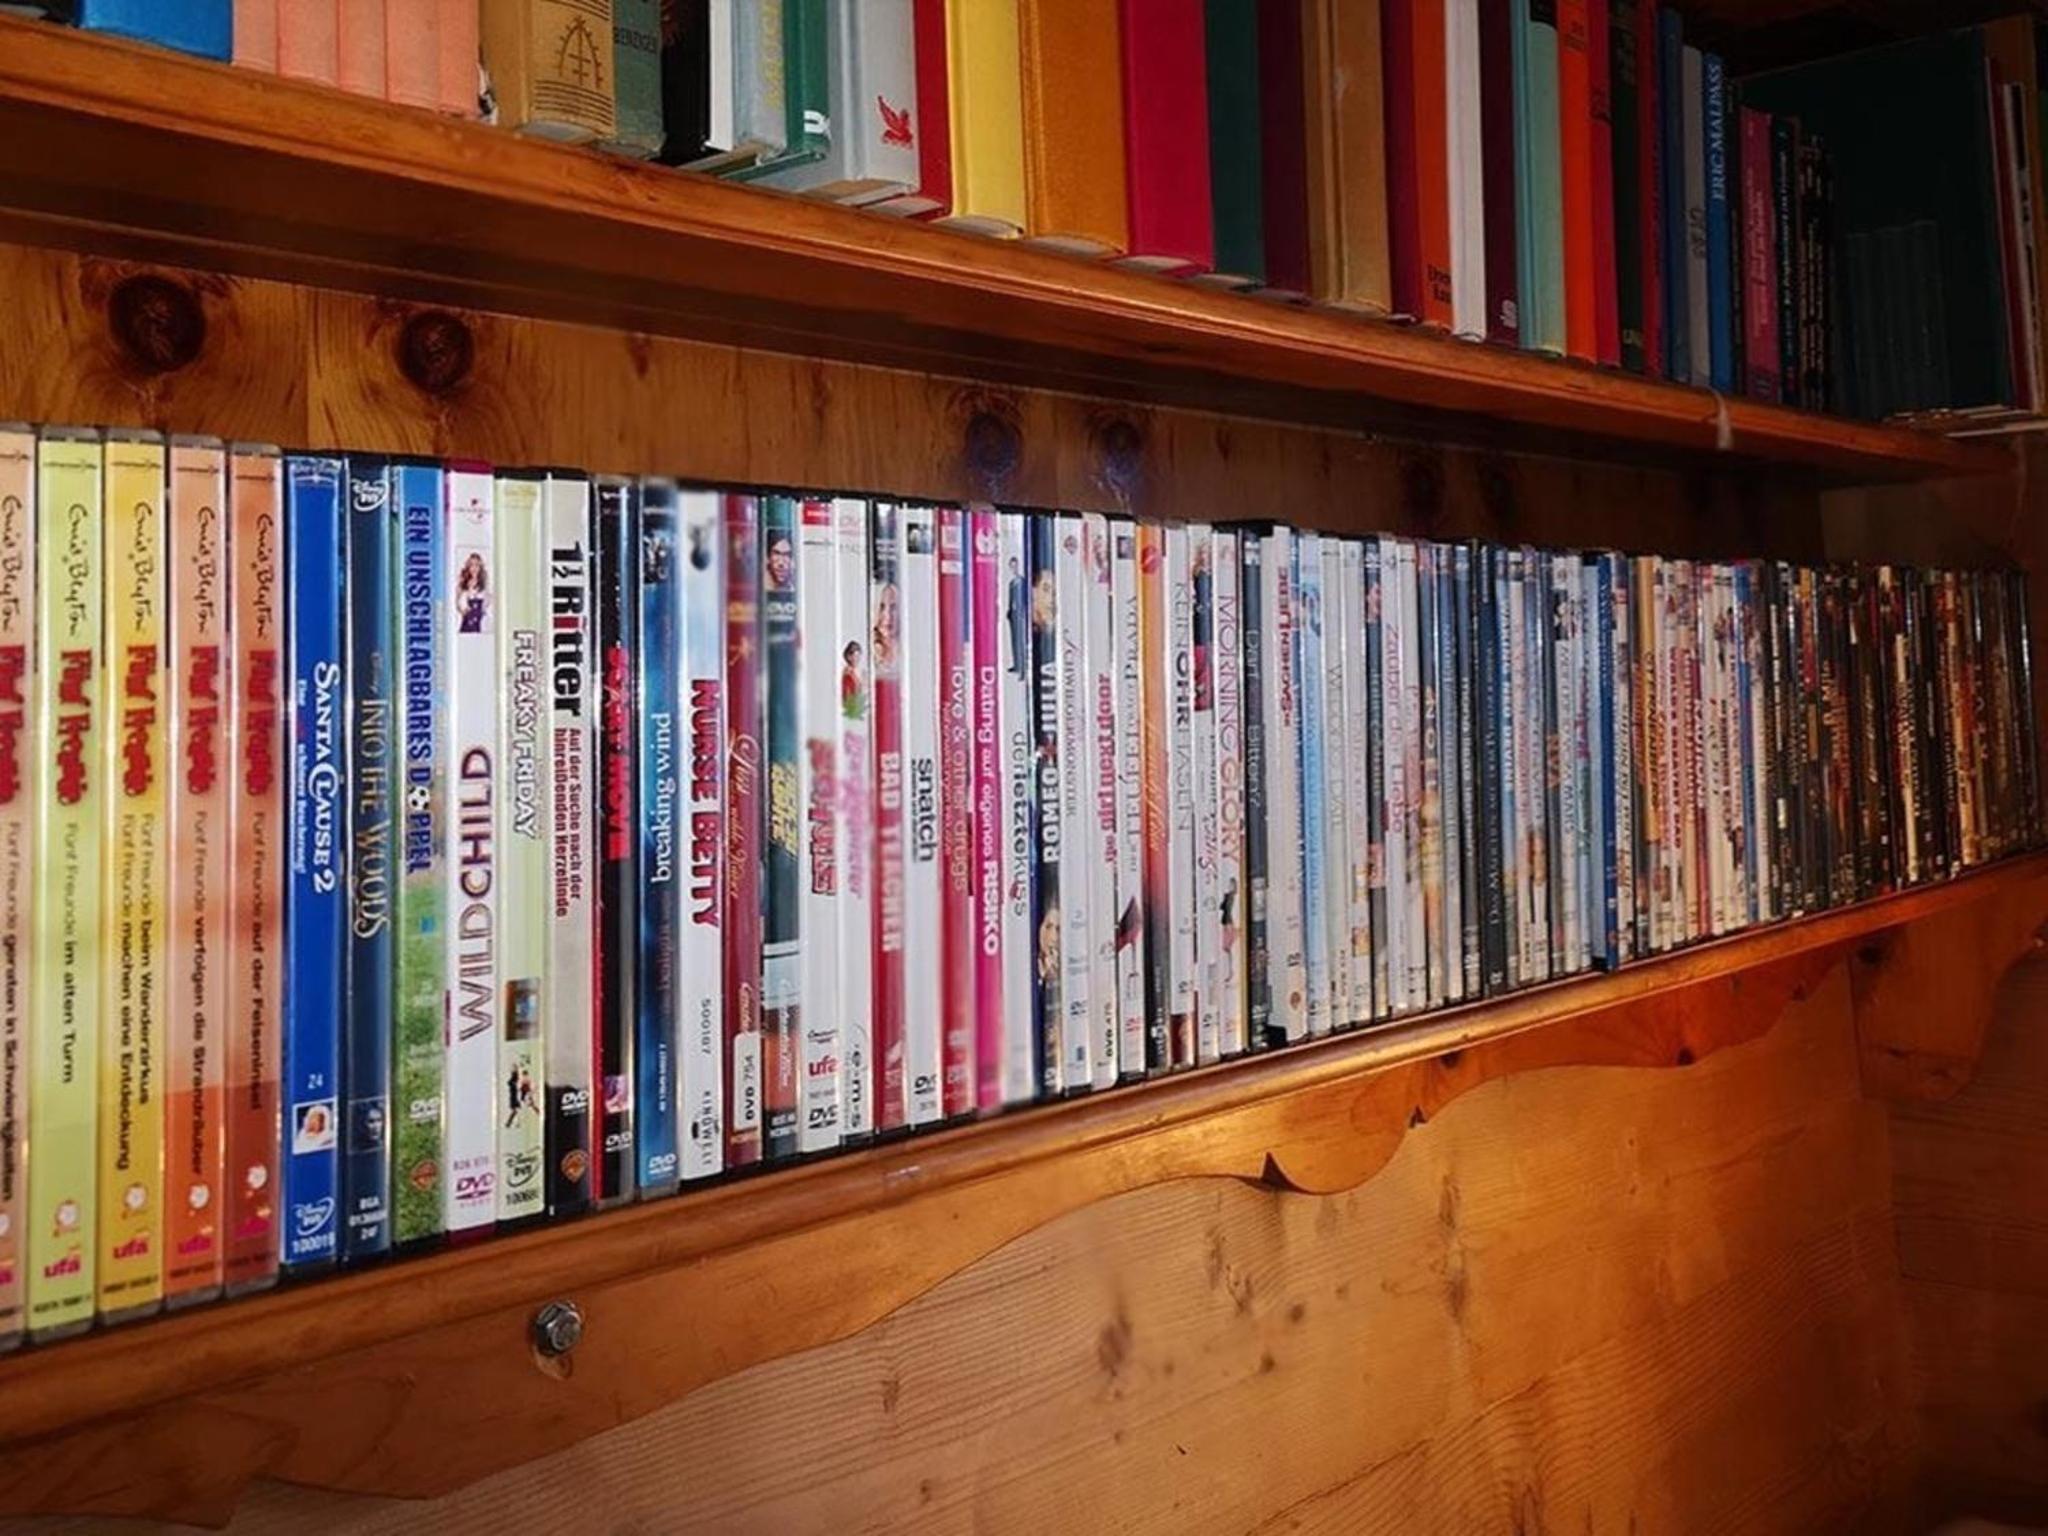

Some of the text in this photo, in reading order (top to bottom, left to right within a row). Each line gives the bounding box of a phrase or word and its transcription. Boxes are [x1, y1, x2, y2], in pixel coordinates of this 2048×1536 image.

[407, 506, 432, 543] EIN
[406, 550, 432, 759] UNSCHLAGBARES
[552, 586, 587, 718] Ritter
[1124, 595, 1138, 681] PRADA
[513, 632, 538, 737] FREAKY
[977, 665, 997, 743] Dating
[1096, 674, 1111, 730] door
[361, 699, 390, 758] INTO
[650, 712, 669, 772] wind
[982, 748, 994, 777] auf
[1040, 661, 1060, 863] ROMEO JULIA
[1098, 735, 1114, 787] next
[1219, 594, 1240, 862] MORNING GLORY
[309, 662, 341, 894] SANTA CLAUSE 2
[361, 767, 389, 816] THE
[691, 679, 720, 928] NURSE BETTY
[880, 751, 900, 810] BAD
[917, 758, 938, 862] snatch
[950, 664, 970, 892] love & other drugs
[1097, 790, 1115, 831] girl
[554, 727, 569, 917] hinreißenden Herzelinde
[569, 728, 583, 899] Auf der Suche nach der
[649, 778, 675, 882] breaking
[353, 820, 392, 938] WOODS
[982, 860, 1000, 955] RISIKO
[66, 941, 79, 965] im
[121, 922, 135, 1000] machen
[140, 920, 154, 966] beim
[190, 916, 207, 1007] verfolgen
[252, 922, 266, 953] auf
[2, 934, 19, 1012] geraten
[66, 972, 79, 1024] alten
[252, 959, 266, 991] der
[6, 1018, 19, 1033] in
[66, 1031, 79, 1086] Turm
[121, 1006, 134, 1045] eine
[140, 973, 154, 1103] Wanderzirkus
[194, 1013, 206, 1041] die
[251, 998, 266, 1108] Felseninsel
[116, 1053, 134, 1170] Entdeckung
[191, 1047, 206, 1174] Strandräuber
[308, 1074, 324, 1090] 24
[562, 1090, 590, 1106] DVD
[745, 1087, 755, 1121] DVD
[1, 1040, 19, 1201] Schwierigkeiten
[606, 1132, 633, 1149] DVD
[457, 1172, 495, 1192] DVD
[649, 1154, 677, 1170] DVD
